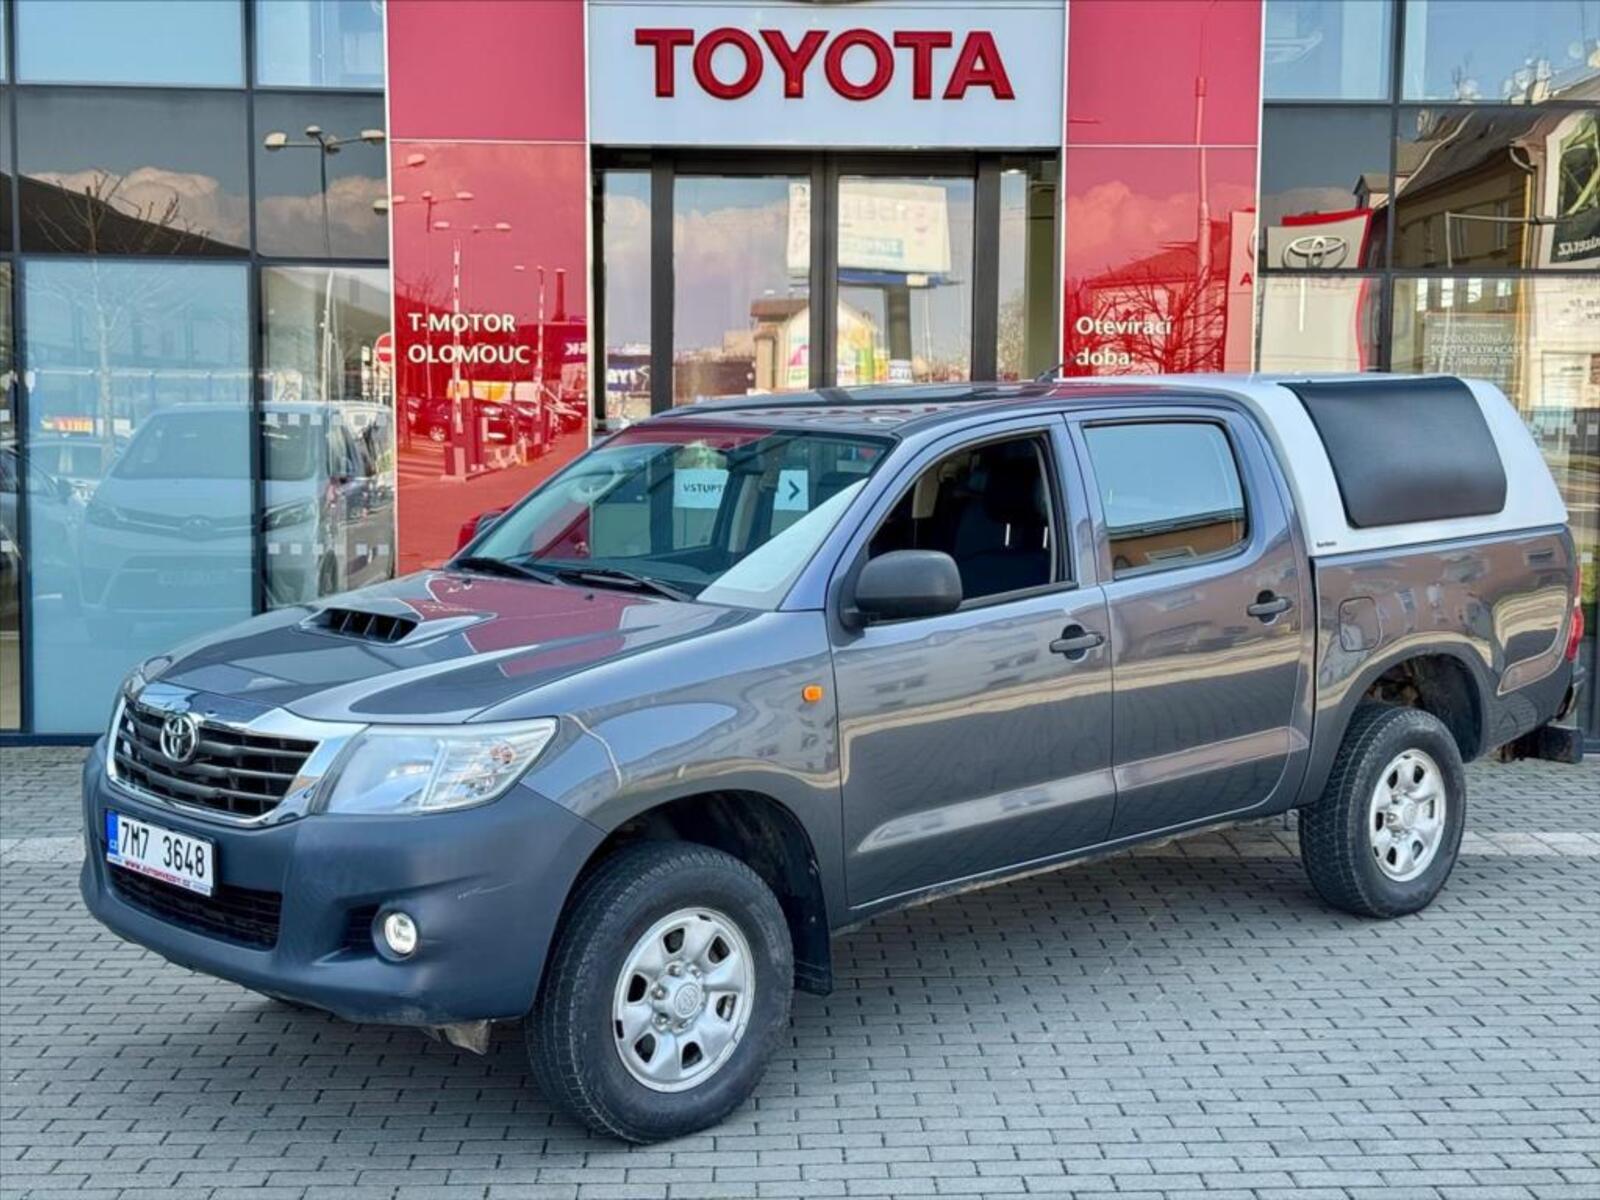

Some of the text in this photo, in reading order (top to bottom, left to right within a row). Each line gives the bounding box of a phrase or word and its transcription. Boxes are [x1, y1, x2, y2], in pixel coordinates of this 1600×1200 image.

[635, 27, 1015, 101] TOYOTA
[408, 313, 516, 333] T-MOTOR
[1076, 315, 1172, 335] Otevírací
[408, 344, 530, 364] OLOMOUC
[122, 821, 205, 879] 7M7 3648
